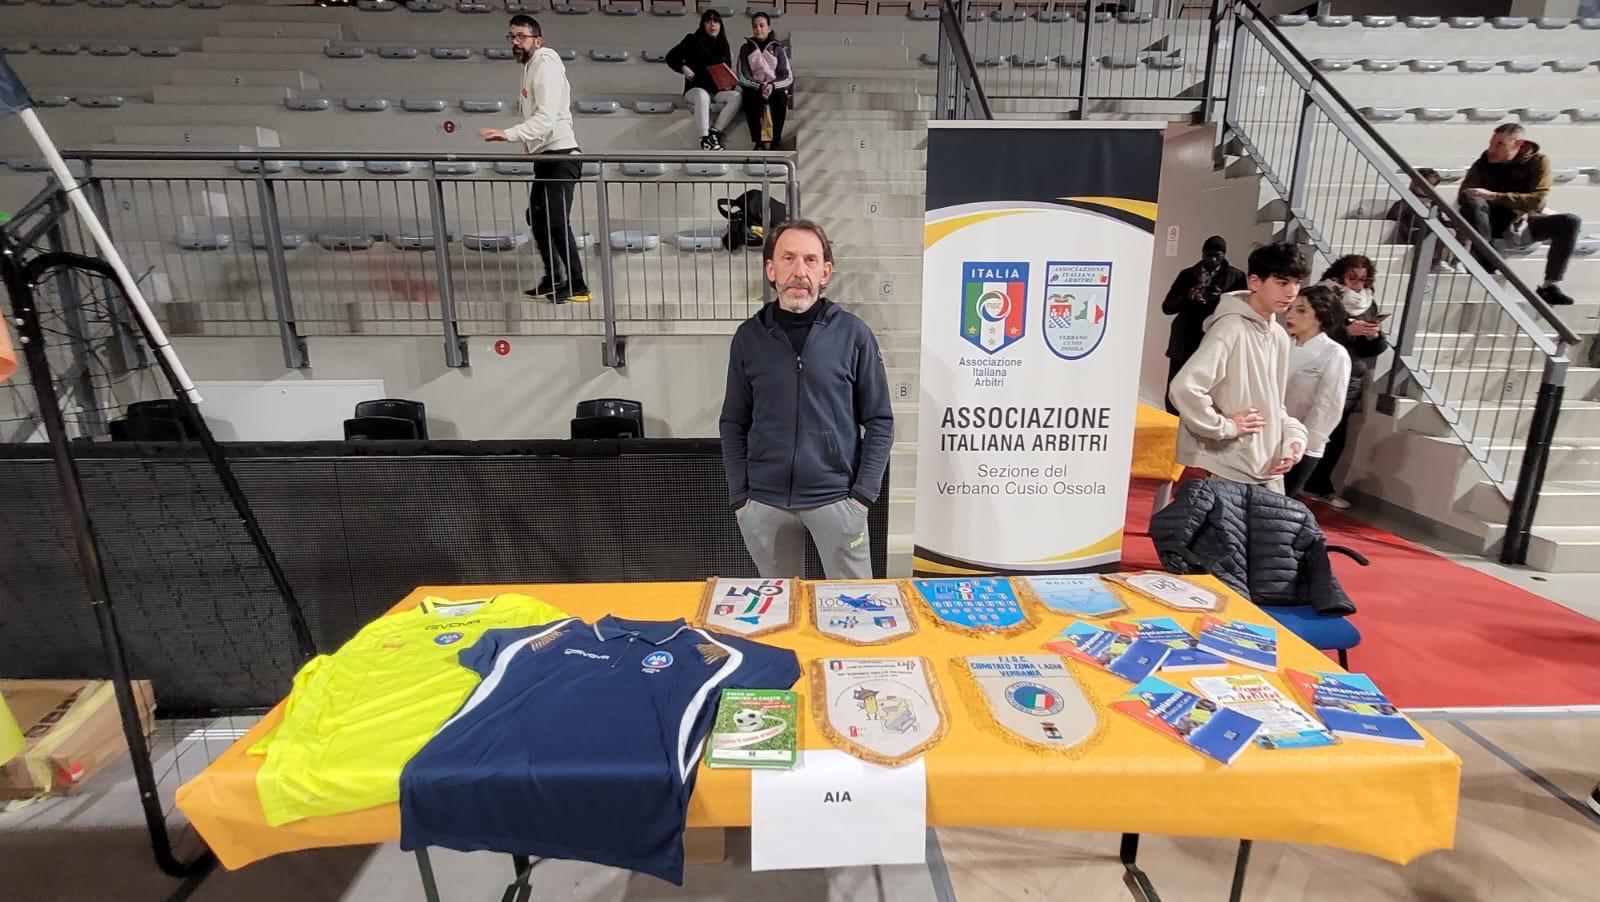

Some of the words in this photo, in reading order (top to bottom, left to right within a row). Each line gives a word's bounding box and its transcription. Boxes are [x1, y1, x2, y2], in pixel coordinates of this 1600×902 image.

[859, 140, 866, 148] E
[870, 204, 877, 213] D
[971, 269, 1020, 278] ITALIA
[883, 284, 890, 294] C
[958, 357, 1023, 367] Associazione
[972, 367, 1007, 377] Italiana
[974, 378, 1004, 387] Arbitri
[900, 387, 907, 396] B
[940, 407, 1111, 429] ASSOCIAZIONE
[940, 434, 1025, 452] ITALIANA
[1031, 434, 1108, 452] ARBITRI
[977, 464, 1040, 478] Sezione
[1044, 464, 1067, 477] del
[937, 481, 1000, 495] Verbano
[1005, 481, 1048, 495] Cusio
[1053, 481, 1106, 495] Ossola
[425, 620, 481, 631] GIVOVA
[649, 655, 667, 663] AIA
[970, 662, 1012, 670] COMITATO
[1014, 662, 1036, 670] ZONA
[824, 791, 852, 803] AIA
